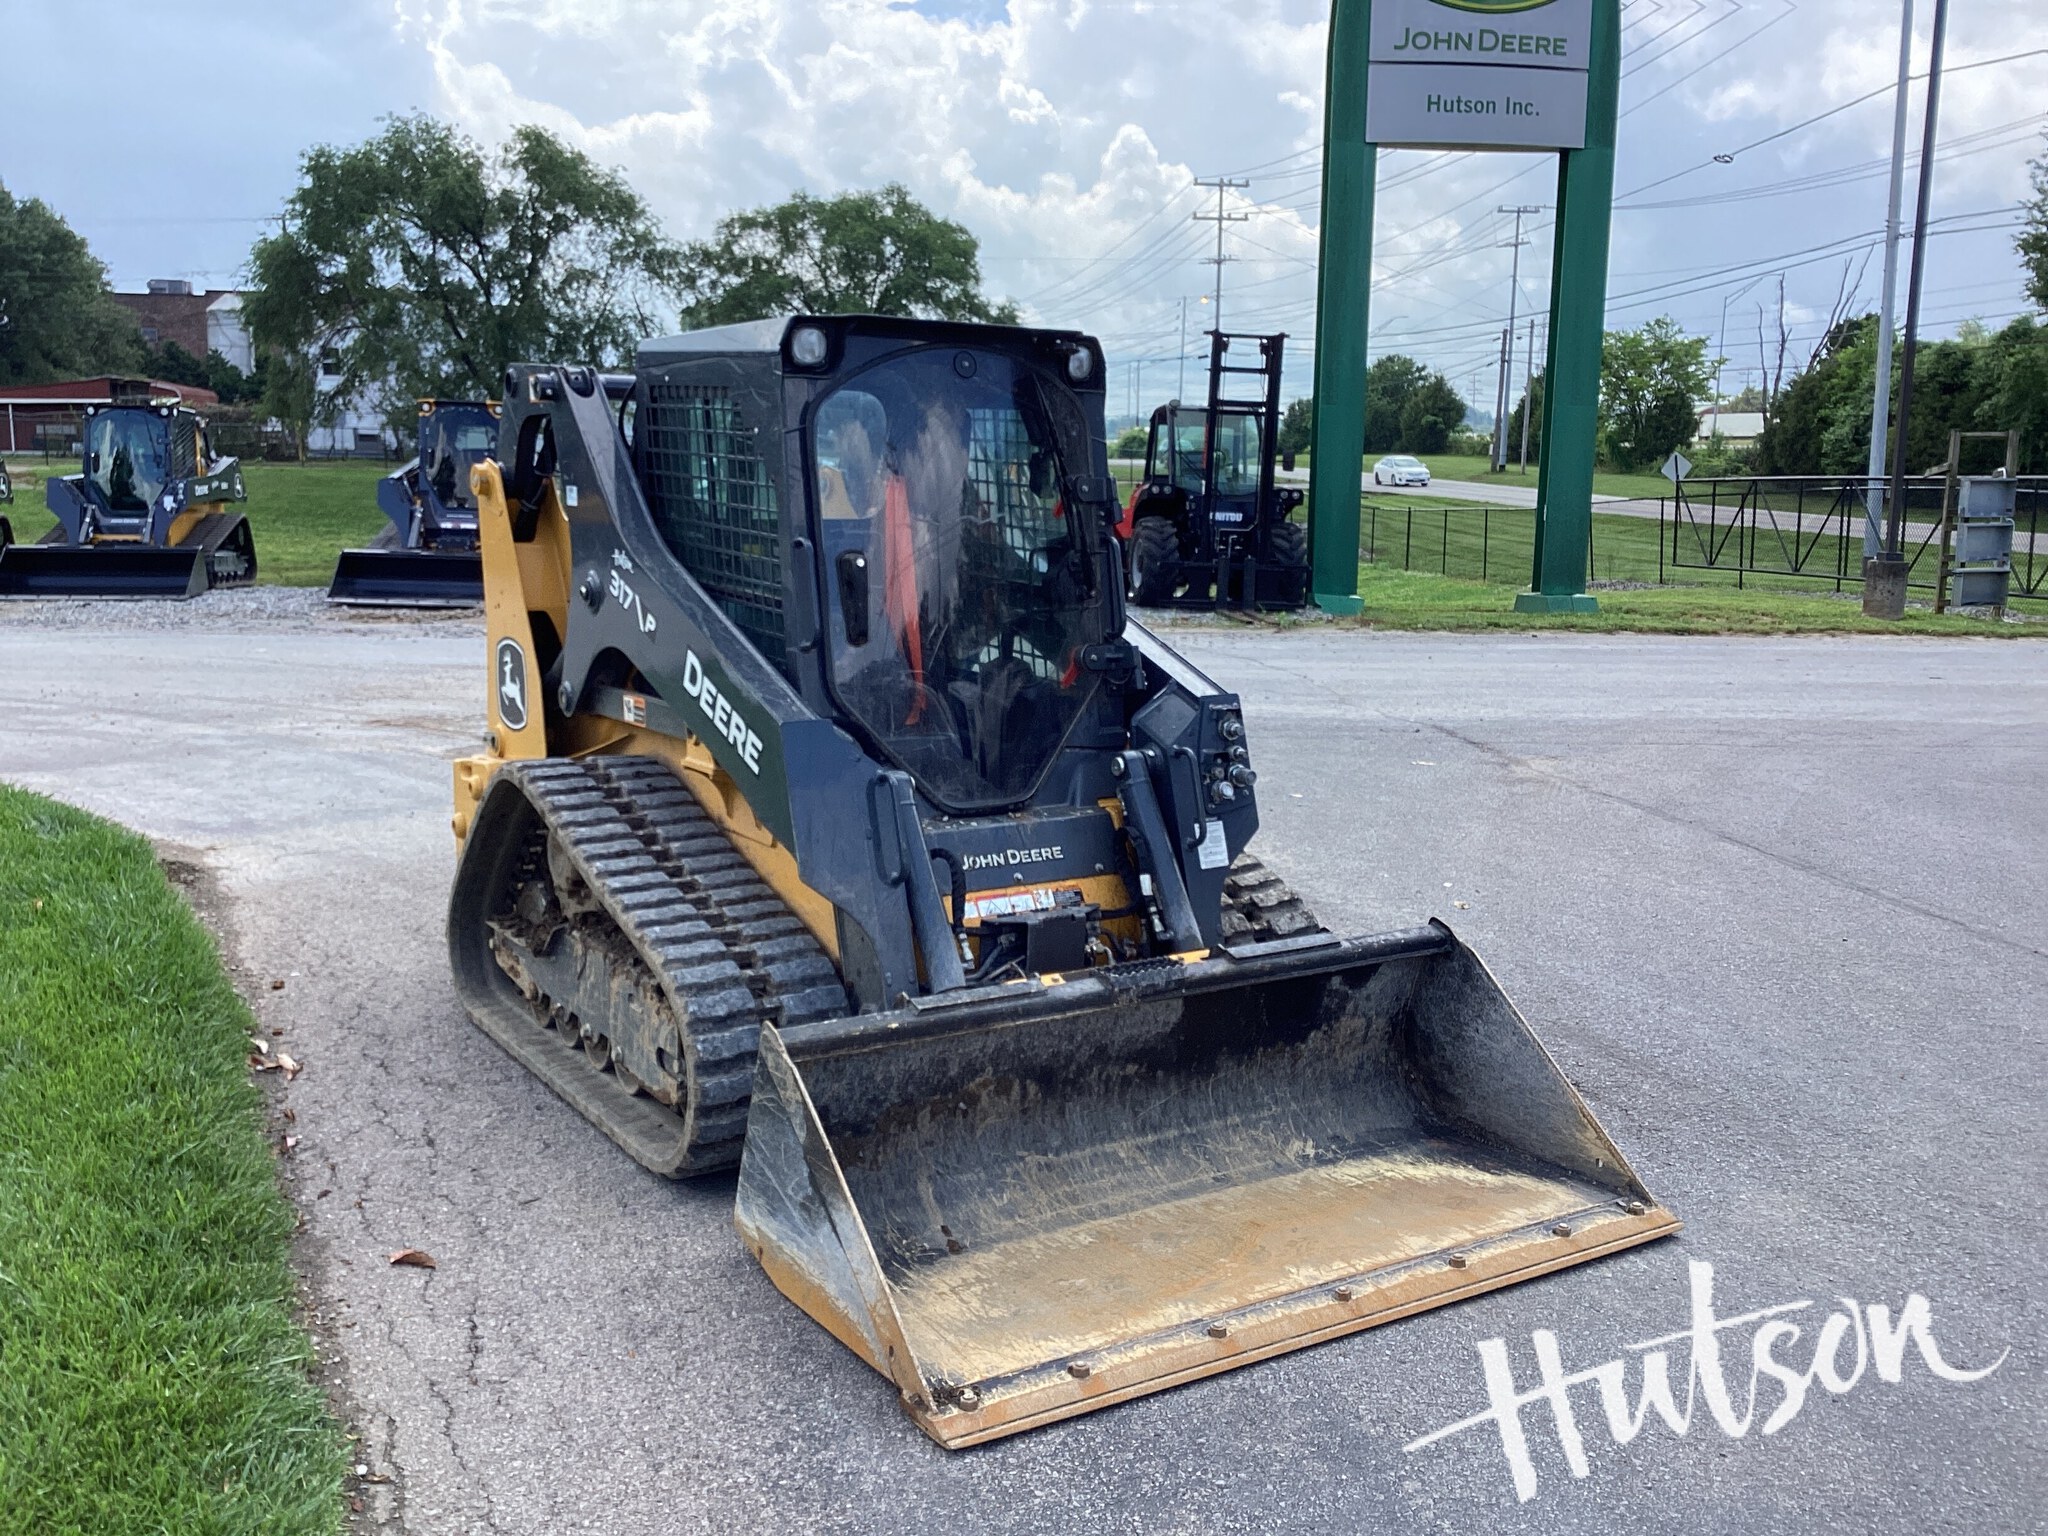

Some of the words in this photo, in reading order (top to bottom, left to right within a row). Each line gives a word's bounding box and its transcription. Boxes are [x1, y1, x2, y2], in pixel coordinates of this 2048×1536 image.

[1394, 27, 1473, 51] JOHN
[1478, 28, 1568, 57] DEERE
[1426, 94, 1497, 115] Hutson
[1505, 96, 1541, 117] Inc.
[682, 649, 764, 776] DEERE
[962, 852, 1006, 871] JOHN
[1006, 845, 1064, 866] DEERE
